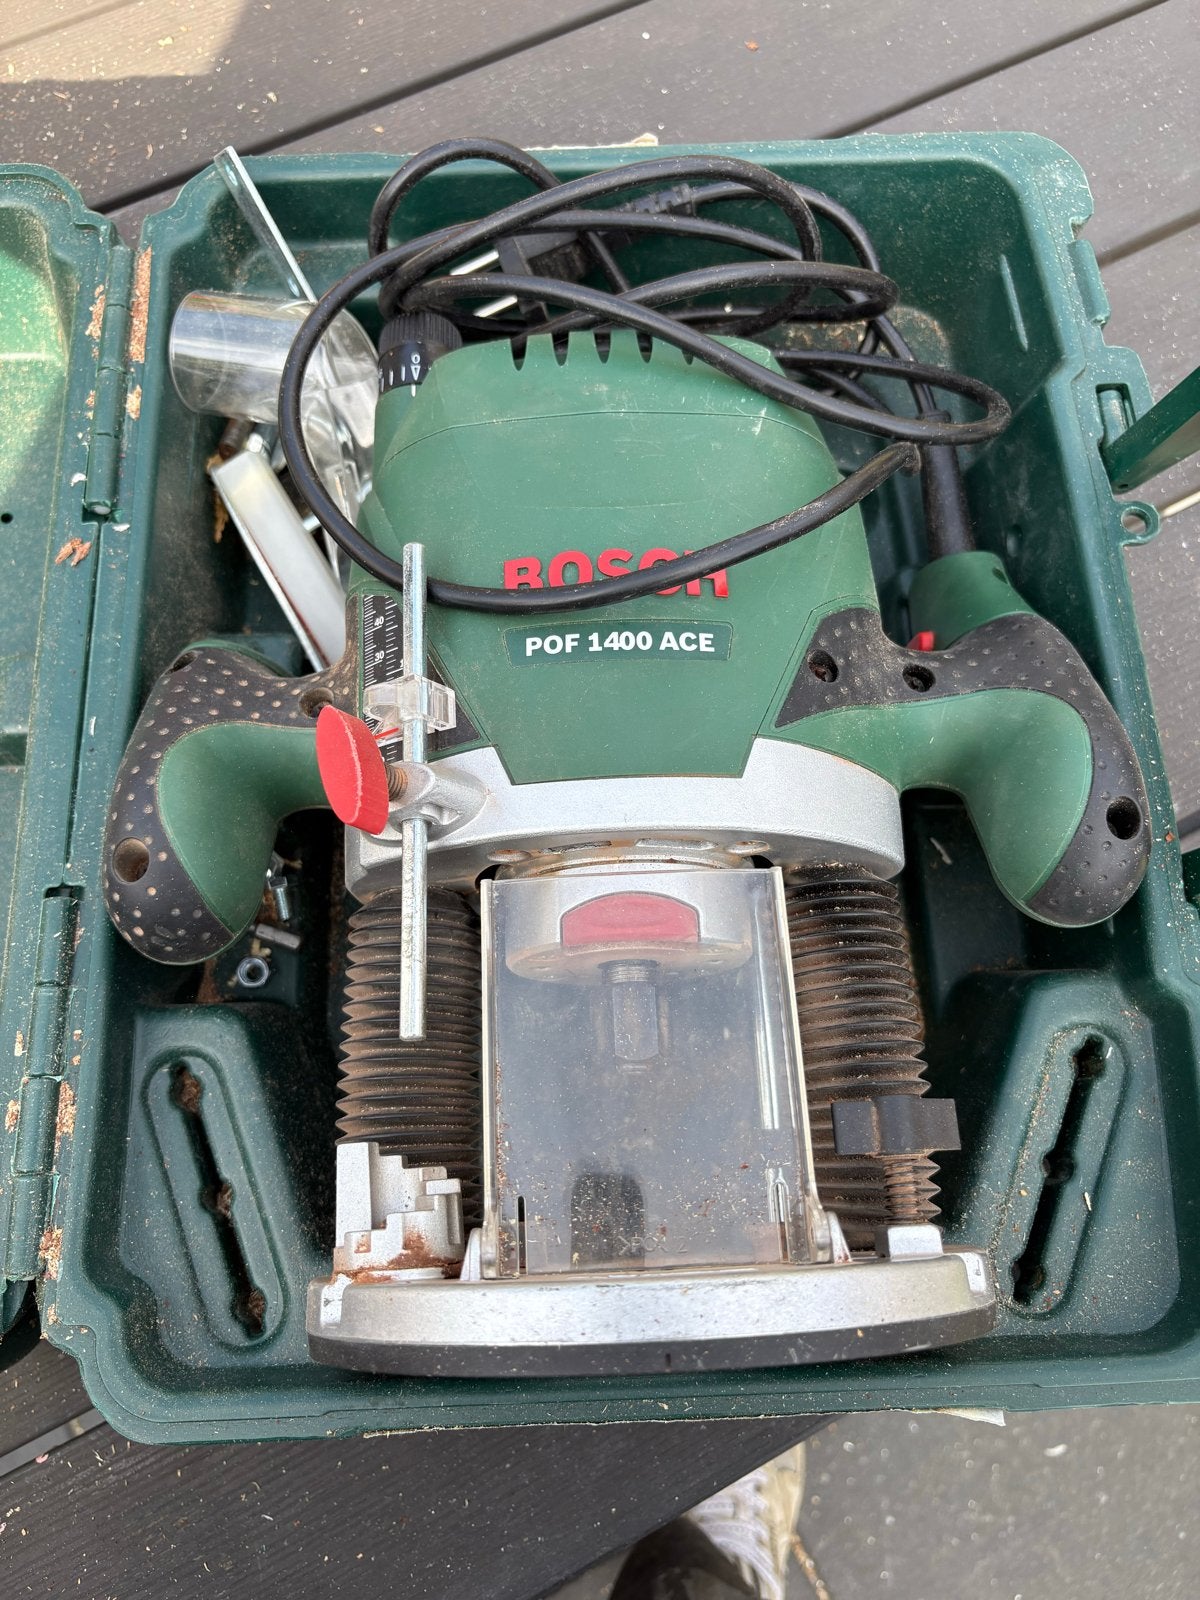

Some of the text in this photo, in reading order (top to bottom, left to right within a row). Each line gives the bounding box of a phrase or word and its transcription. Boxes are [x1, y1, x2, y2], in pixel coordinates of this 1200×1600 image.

[374, 616, 385, 626] 40
[525, 630, 715, 657] POF 1400 ACE
[374, 650, 385, 661] 30
